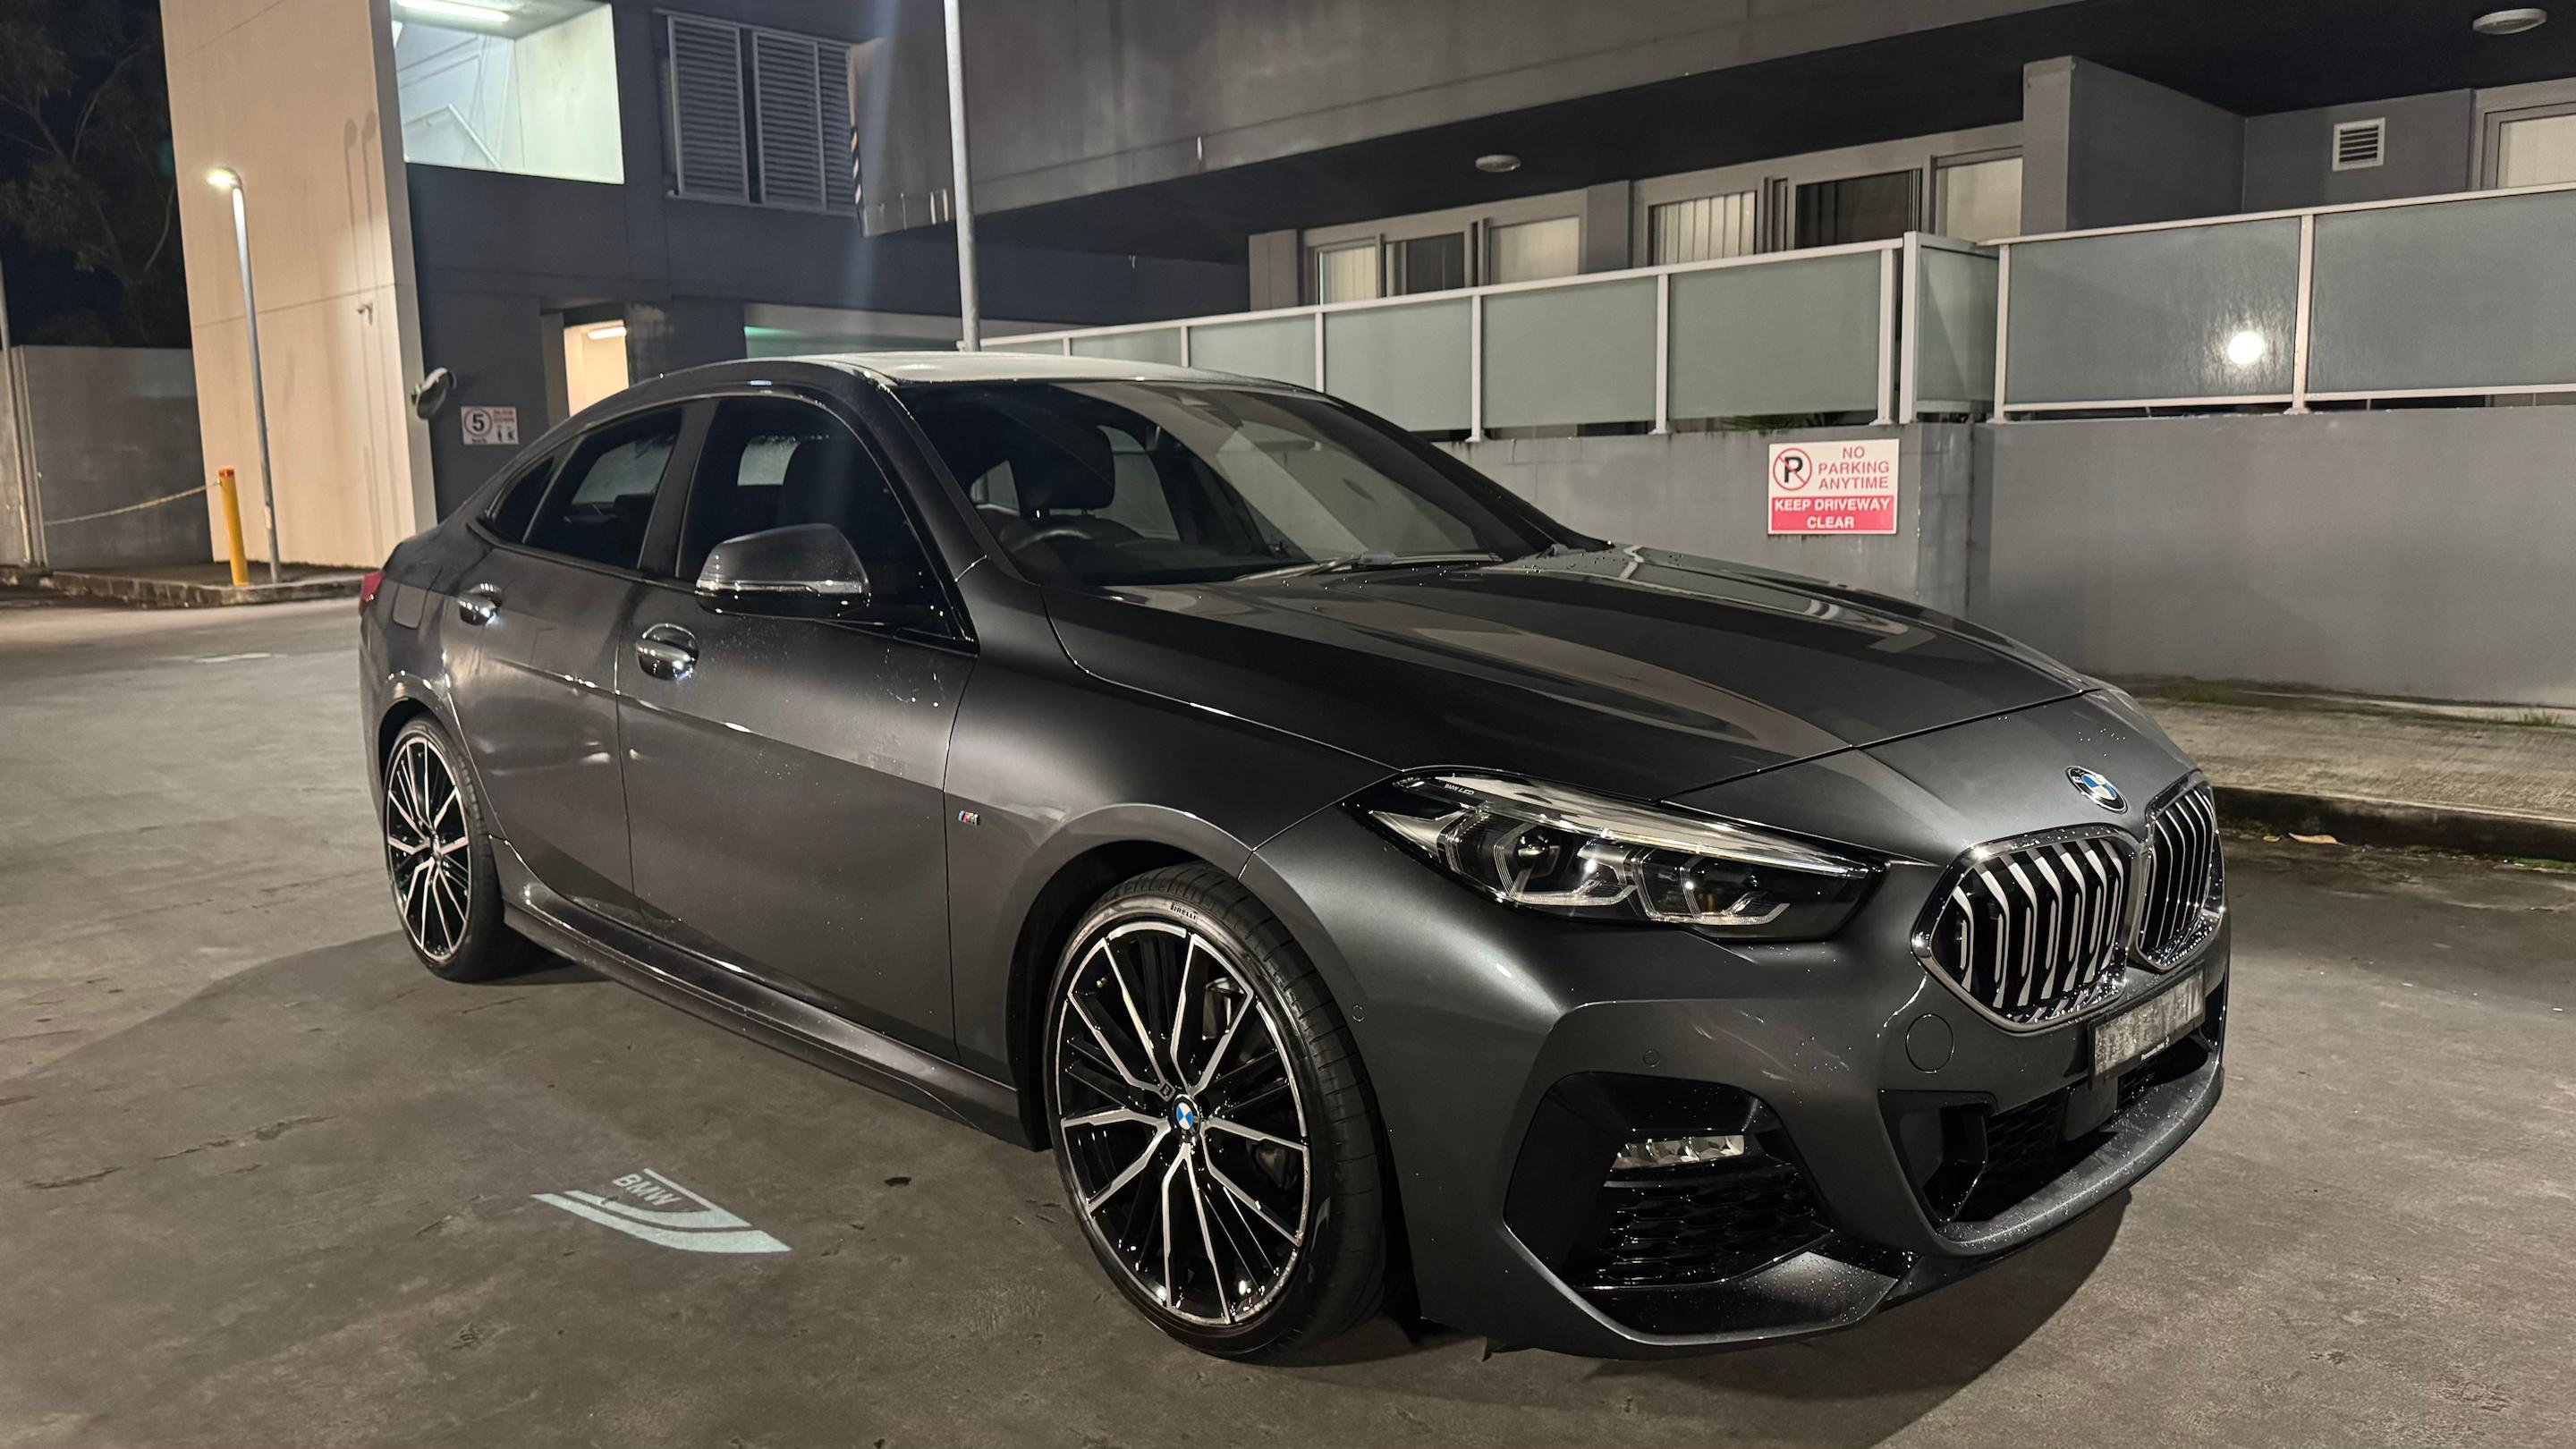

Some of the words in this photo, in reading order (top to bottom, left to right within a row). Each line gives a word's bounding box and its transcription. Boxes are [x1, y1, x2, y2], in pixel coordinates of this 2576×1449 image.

[472, 413, 484, 431] 5
[1843, 446, 1865, 459] NO
[1818, 461, 1889, 474] PARKING
[1818, 476, 1888, 489] ANYTIME
[1775, 498, 1811, 511] KEEP
[1815, 497, 1890, 511] DRIVEWAY
[1807, 516, 1854, 529] CLEAR
[1170, 902, 1198, 919] PIRELLI
[612, 1173, 681, 1206] BMW
